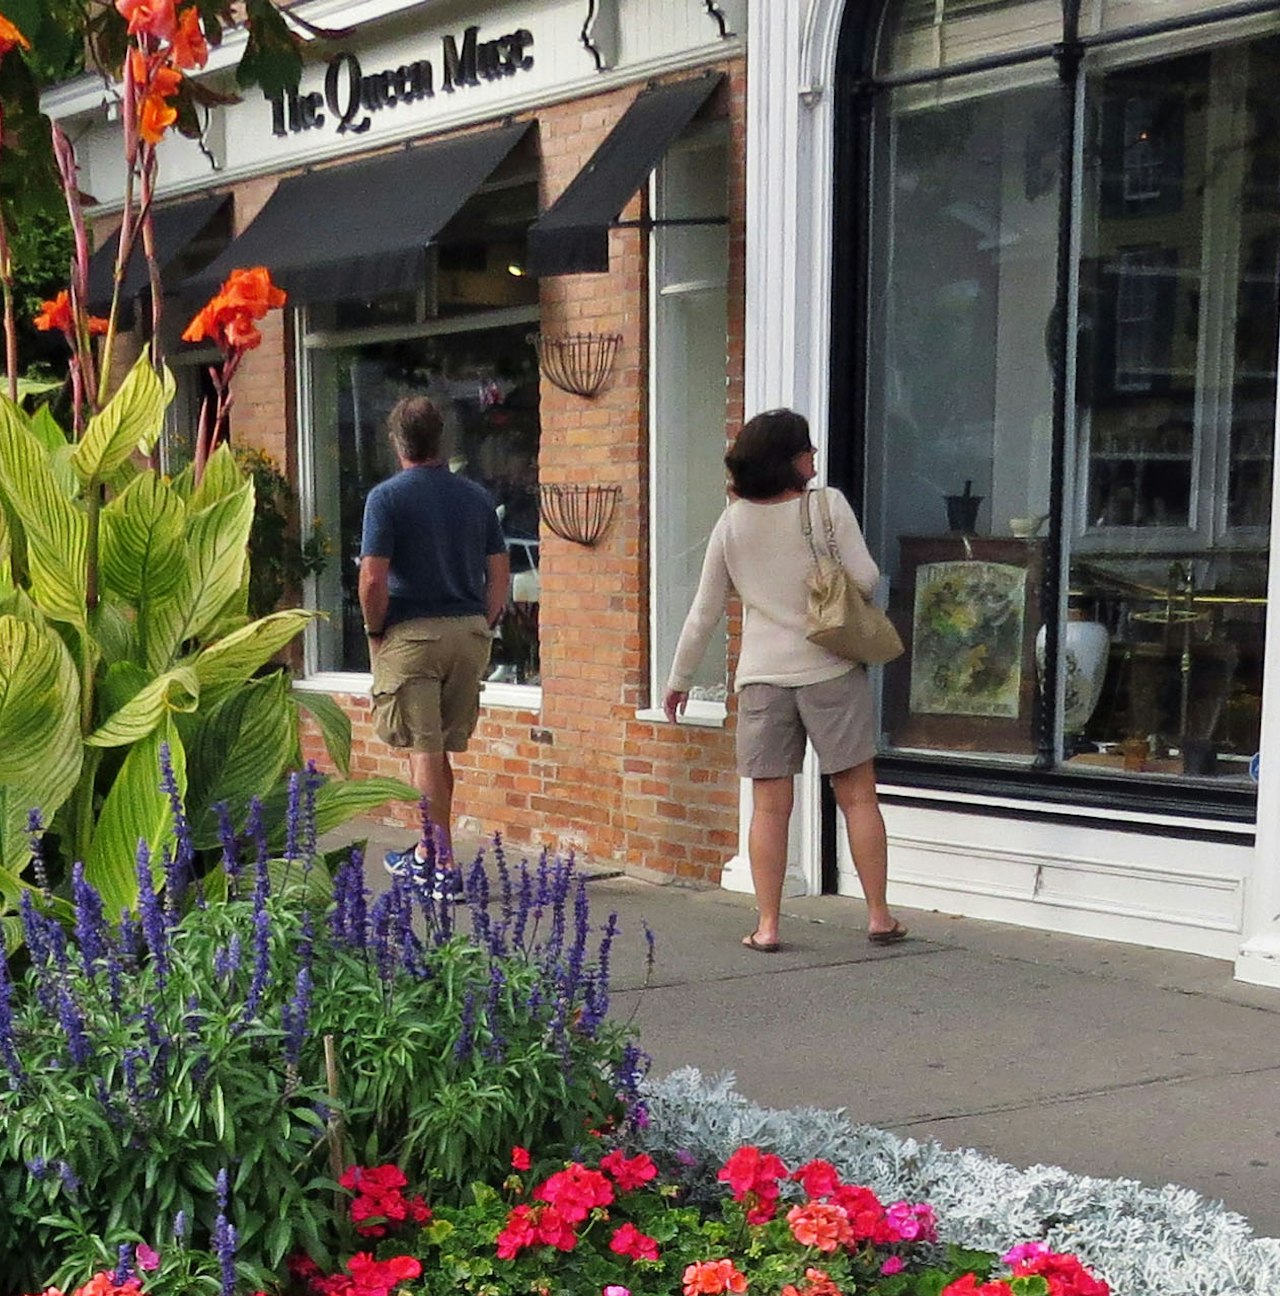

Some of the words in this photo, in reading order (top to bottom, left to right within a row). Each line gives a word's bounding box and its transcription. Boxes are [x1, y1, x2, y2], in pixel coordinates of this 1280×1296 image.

[265, 84, 326, 137] The
[325, 52, 435, 134] Queen
[441, 25, 536, 93] Muse
